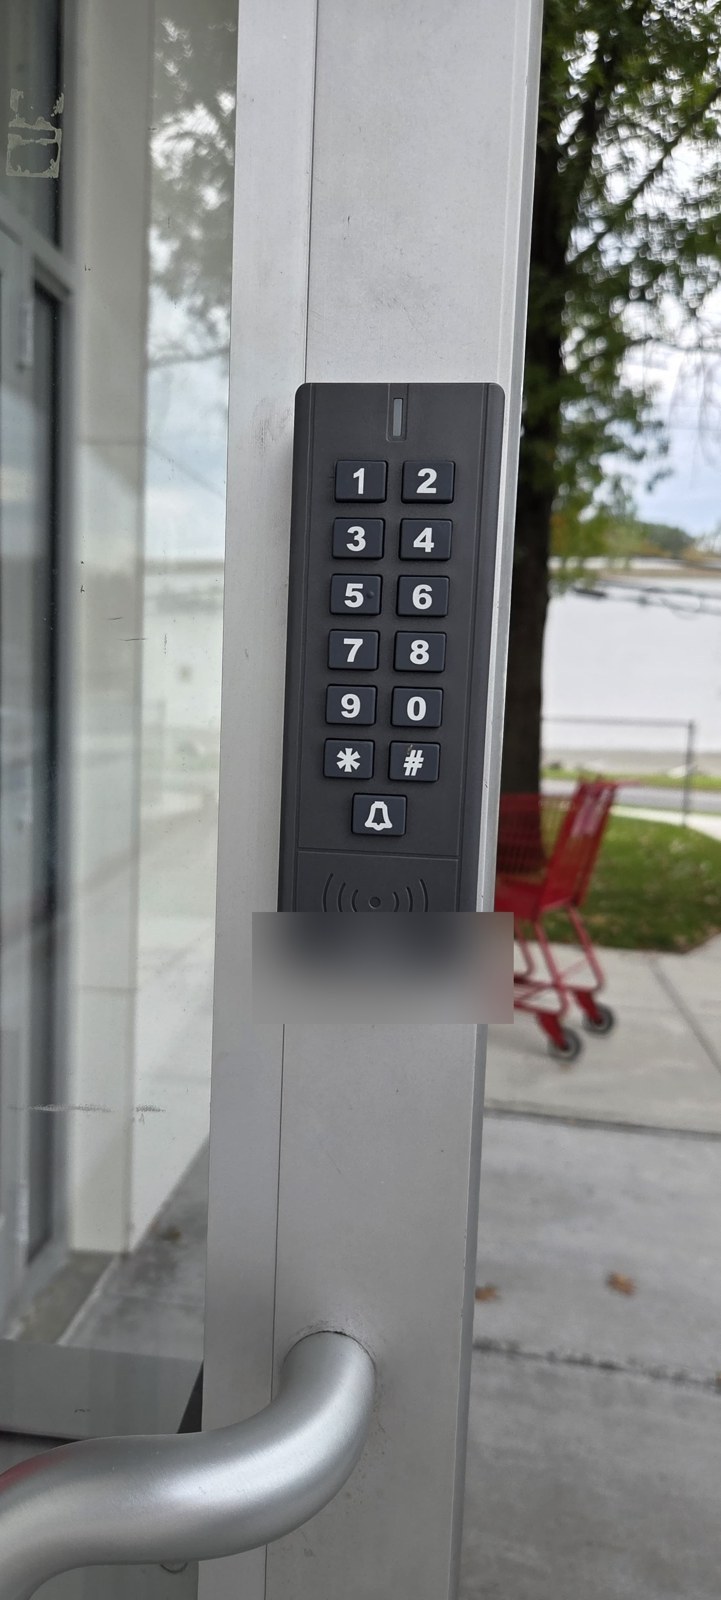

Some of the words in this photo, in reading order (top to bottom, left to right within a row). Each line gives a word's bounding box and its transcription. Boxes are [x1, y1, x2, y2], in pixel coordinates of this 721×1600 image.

[353, 468, 364, 494] 1
[416, 467, 437, 493] 2
[346, 526, 366, 551] 3
[413, 527, 434, 552] 4
[344, 583, 364, 608] 5
[412, 584, 432, 609] 6
[343, 638, 363, 662] 7
[409, 639, 429, 664] 8
[340, 693, 360, 718] 9
[406, 696, 426, 721] 0
[403, 750, 424, 776] #
